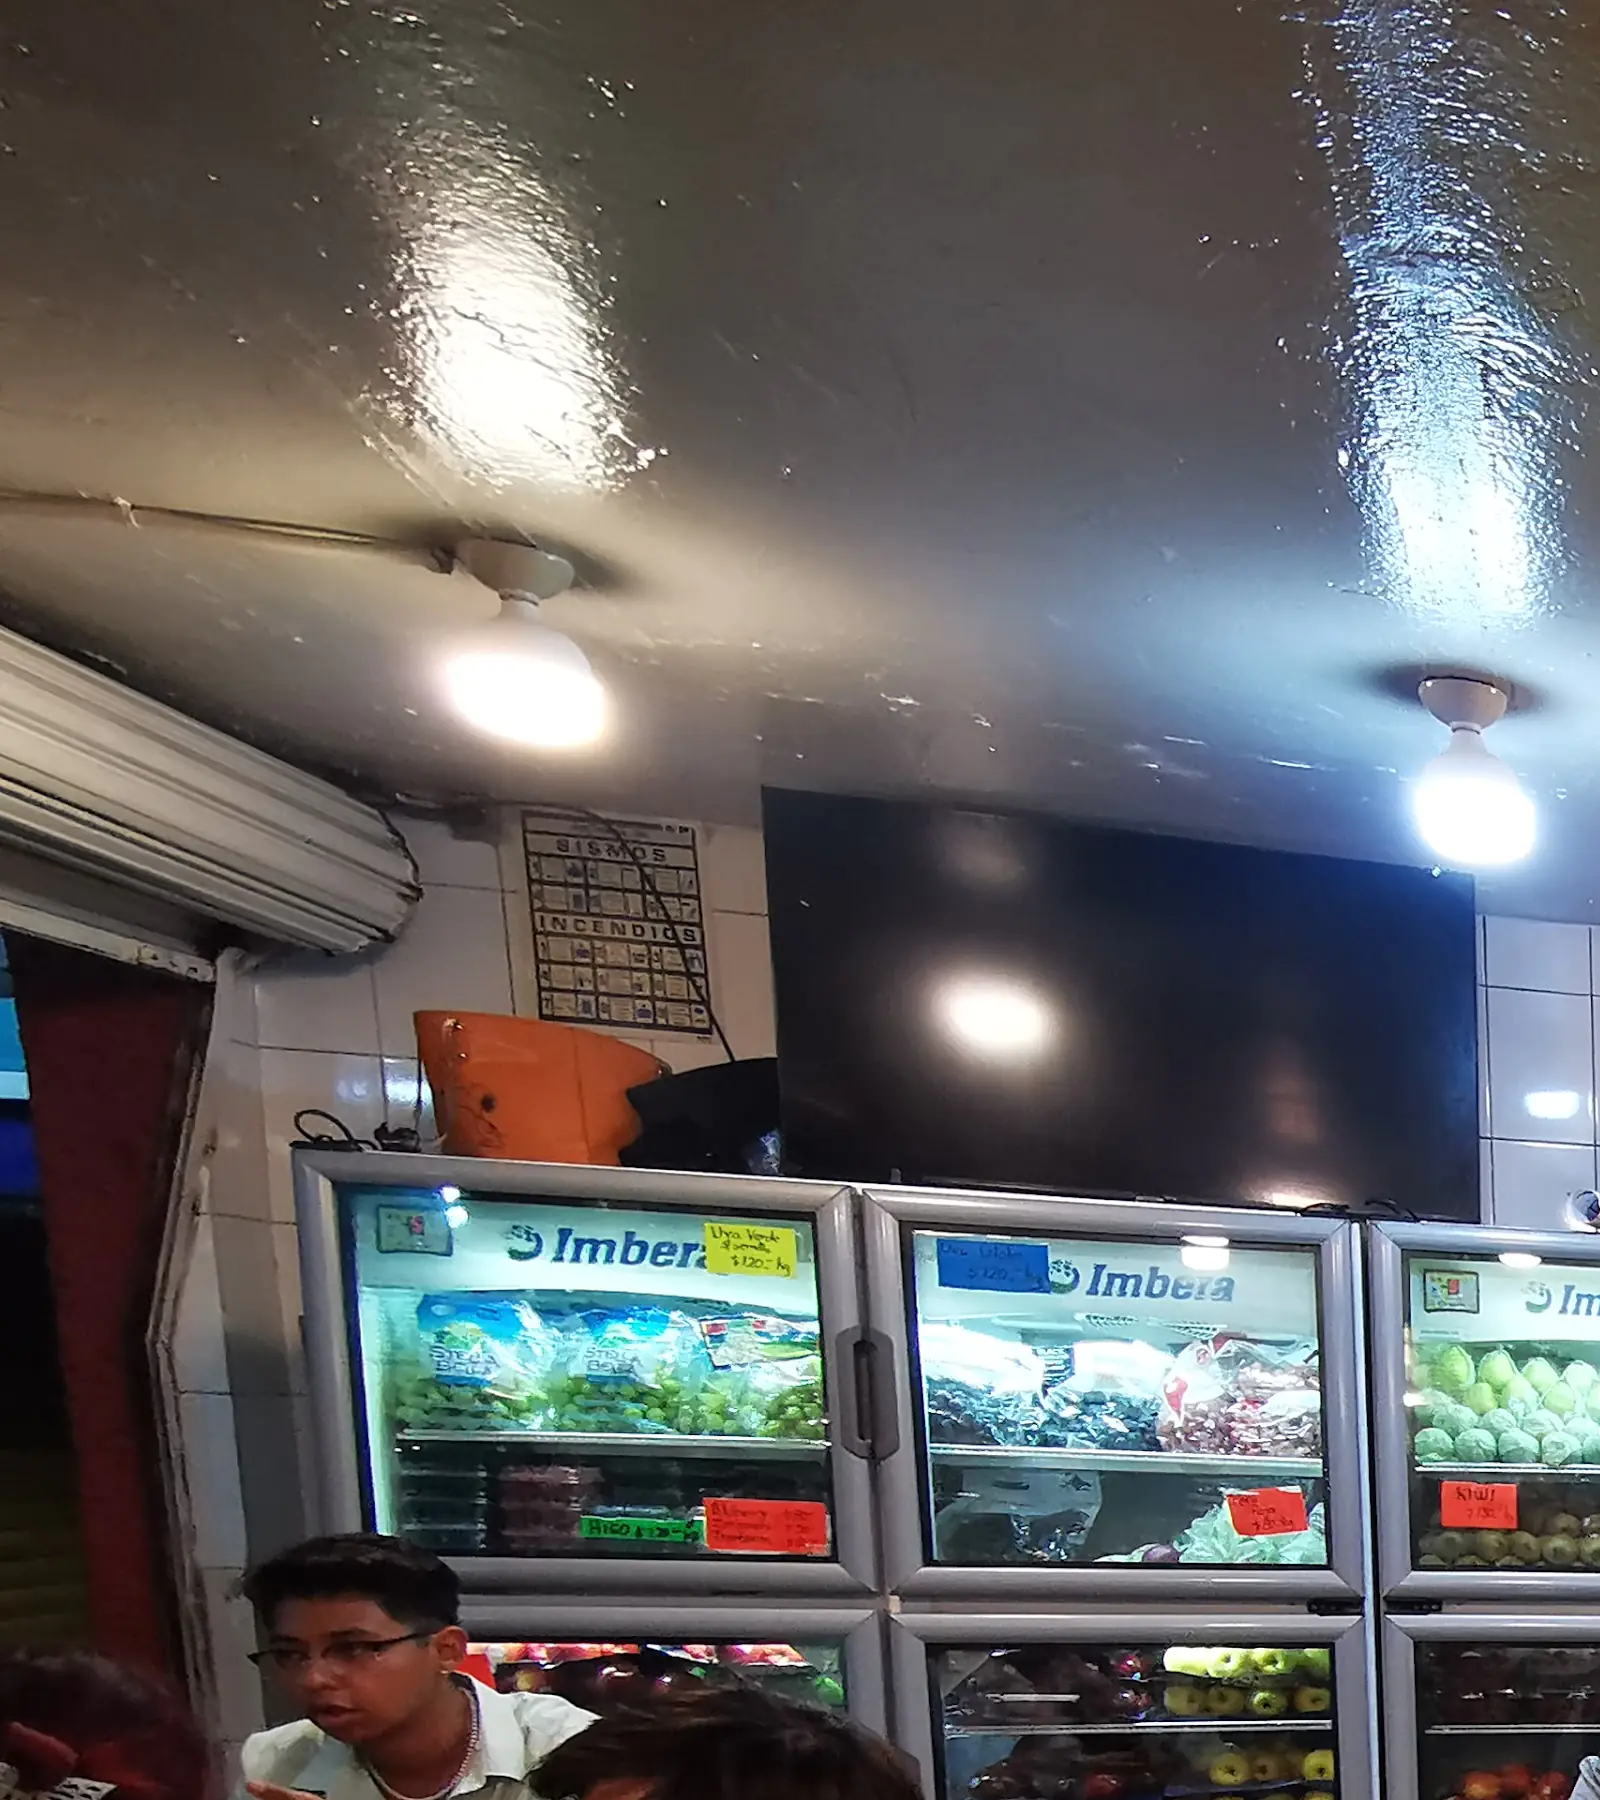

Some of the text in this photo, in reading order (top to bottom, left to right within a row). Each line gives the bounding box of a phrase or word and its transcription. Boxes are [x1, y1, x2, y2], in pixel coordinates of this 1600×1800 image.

[555, 839, 668, 863] SISMOS
[541, 917, 698, 943] INCENDIOS
[1085, 1263, 1235, 1302] Imbera
